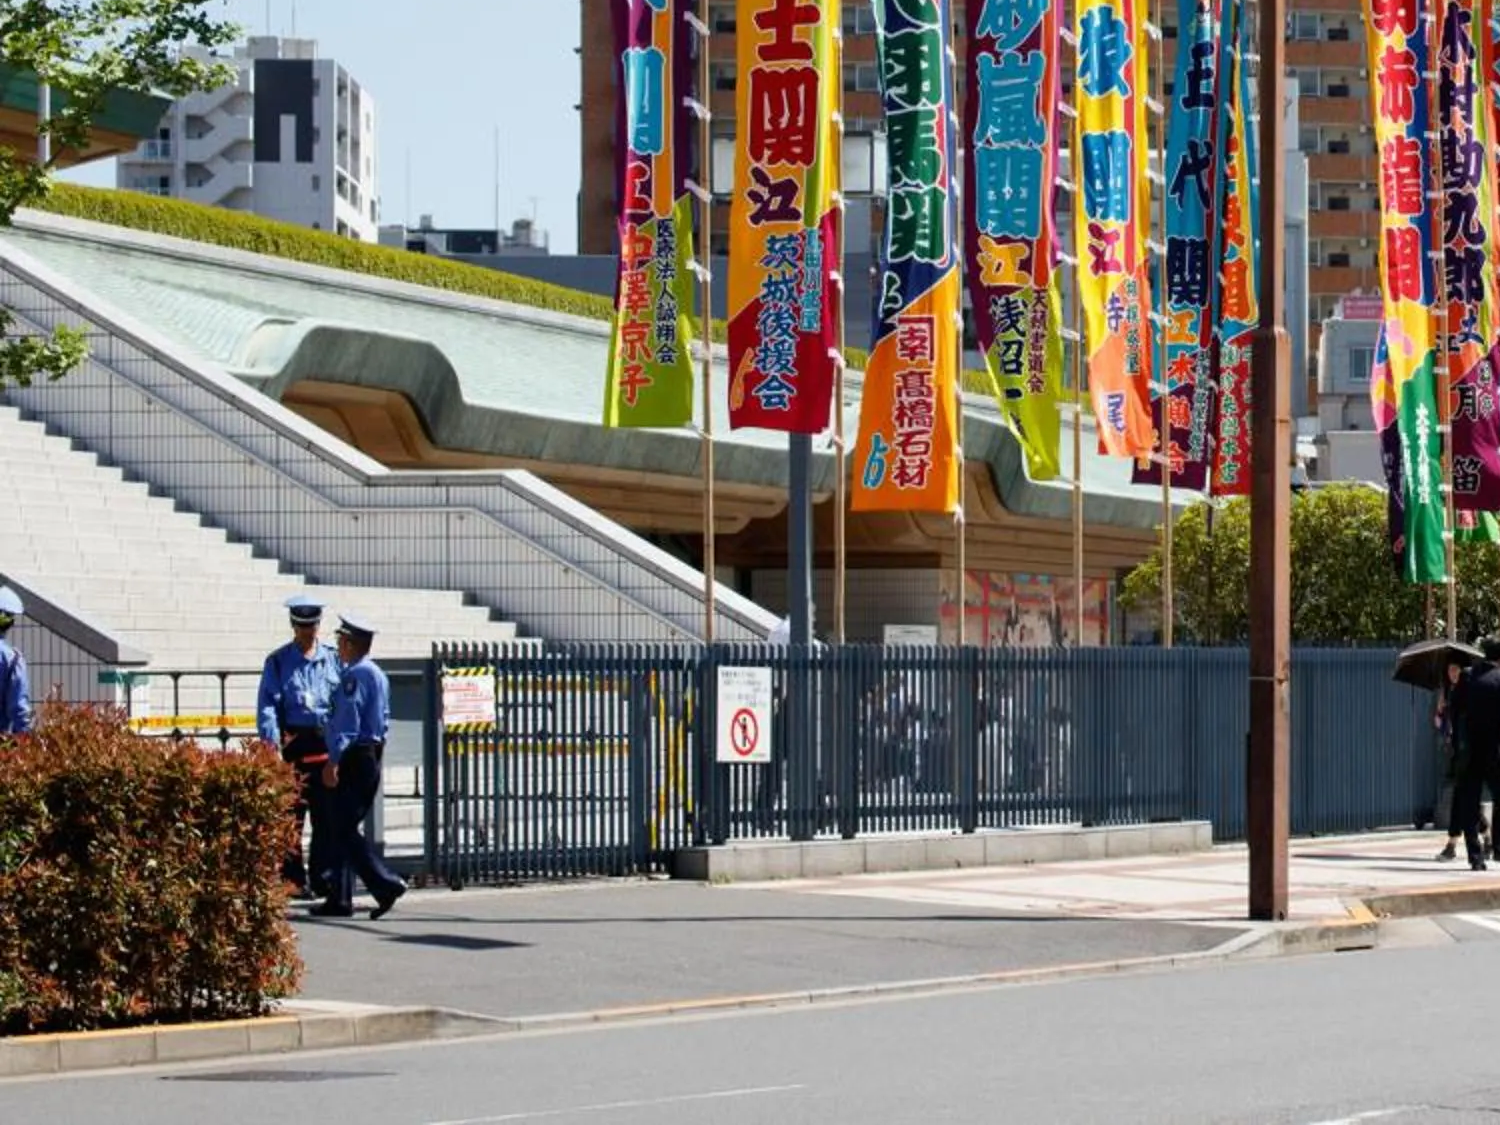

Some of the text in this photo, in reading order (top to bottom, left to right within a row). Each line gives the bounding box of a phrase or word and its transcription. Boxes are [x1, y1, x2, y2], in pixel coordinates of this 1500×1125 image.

[751, 233, 800, 411] 茨城後援会
